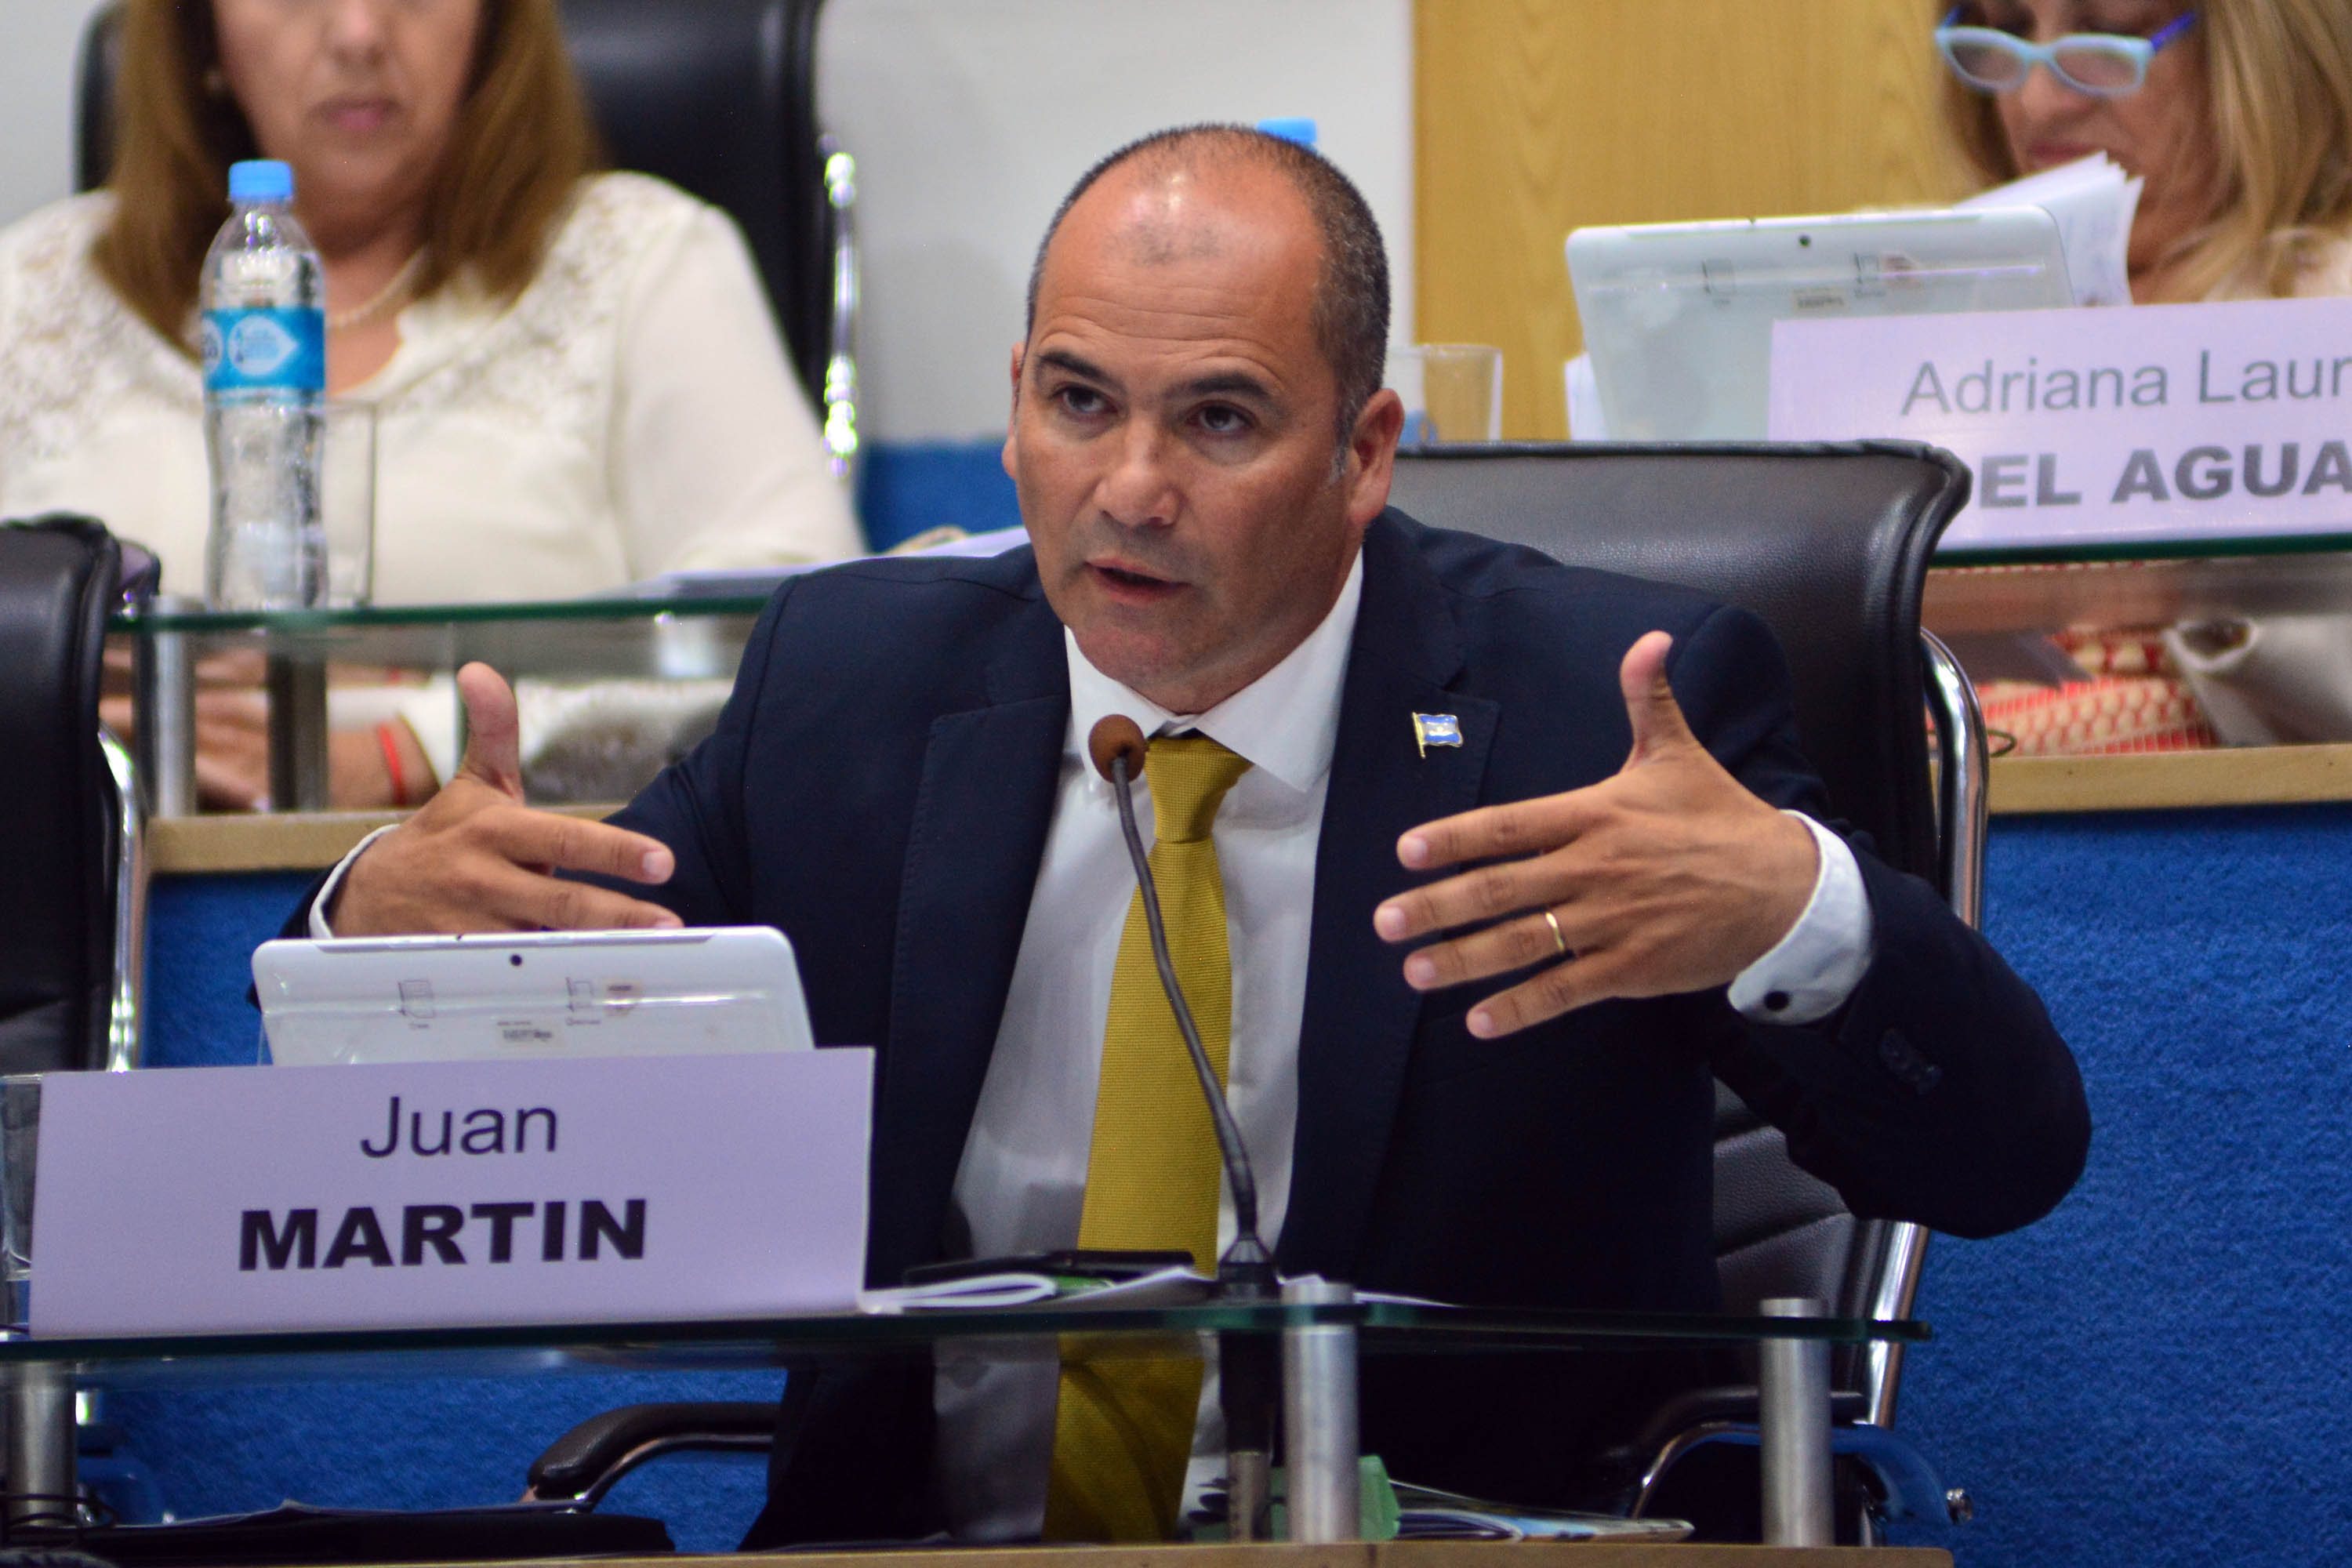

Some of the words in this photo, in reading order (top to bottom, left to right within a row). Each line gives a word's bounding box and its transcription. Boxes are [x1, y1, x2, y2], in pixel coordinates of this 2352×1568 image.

[1900, 358, 2169, 416] Adriana
[2198, 349, 2352, 405] Laur
[2111, 440, 2352, 503] AGUA
[359, 1095, 558, 1159] Juan
[238, 1198, 647, 1272] MARTIN
